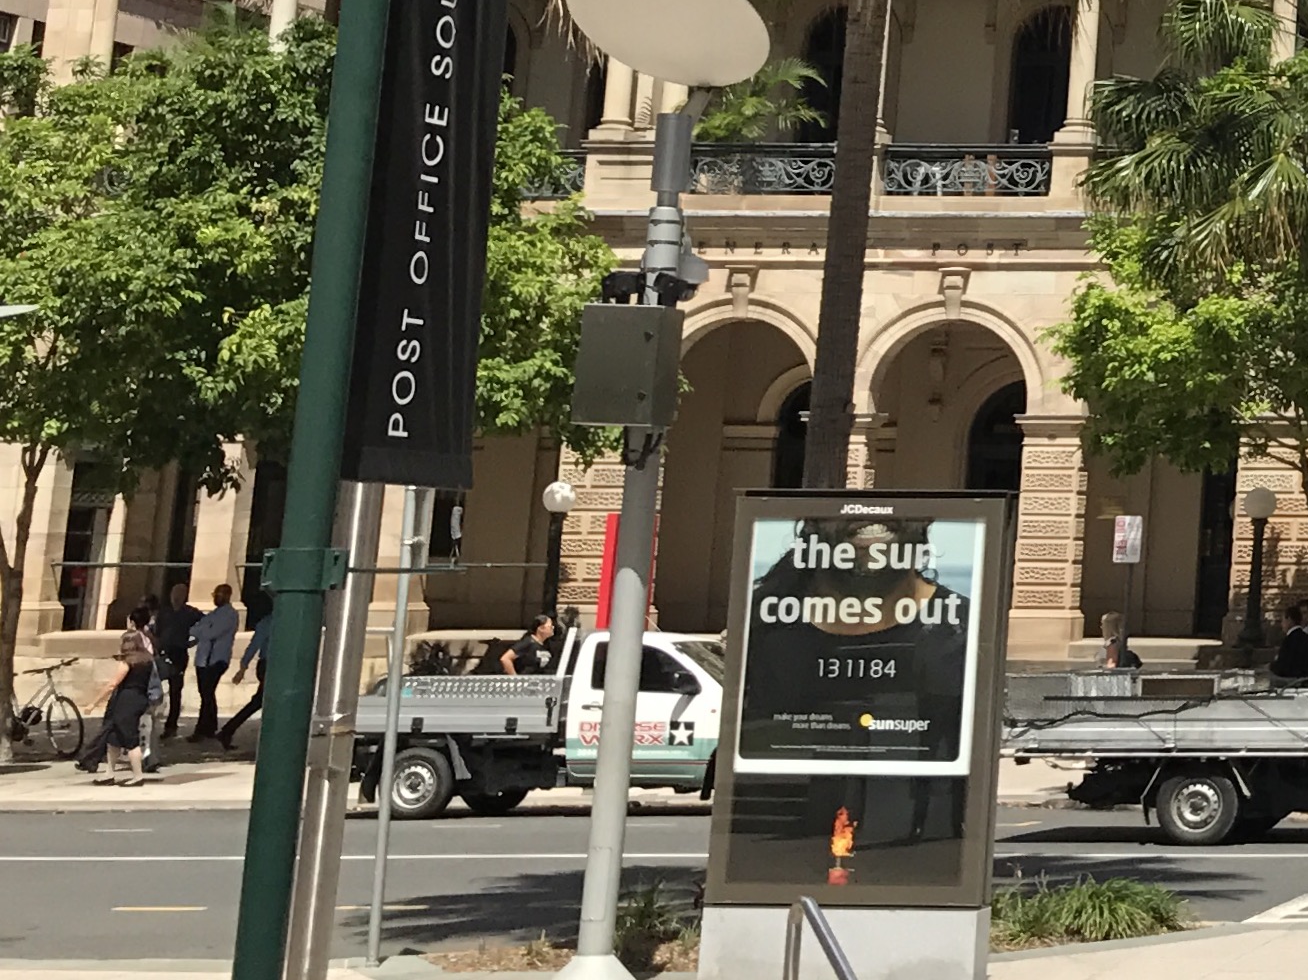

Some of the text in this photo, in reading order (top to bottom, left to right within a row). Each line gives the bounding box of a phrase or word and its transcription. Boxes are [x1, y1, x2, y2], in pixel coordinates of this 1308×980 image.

[931, 242, 1024, 256] POST
[387, 307, 425, 438] POST
[409, 103, 450, 286] OFFICE
[840, 504, 894, 515] JCDecaux
[791, 534, 938, 570] the sun
[759, 593, 962, 625] comes out
[868, 718, 931, 733] sunsuper
